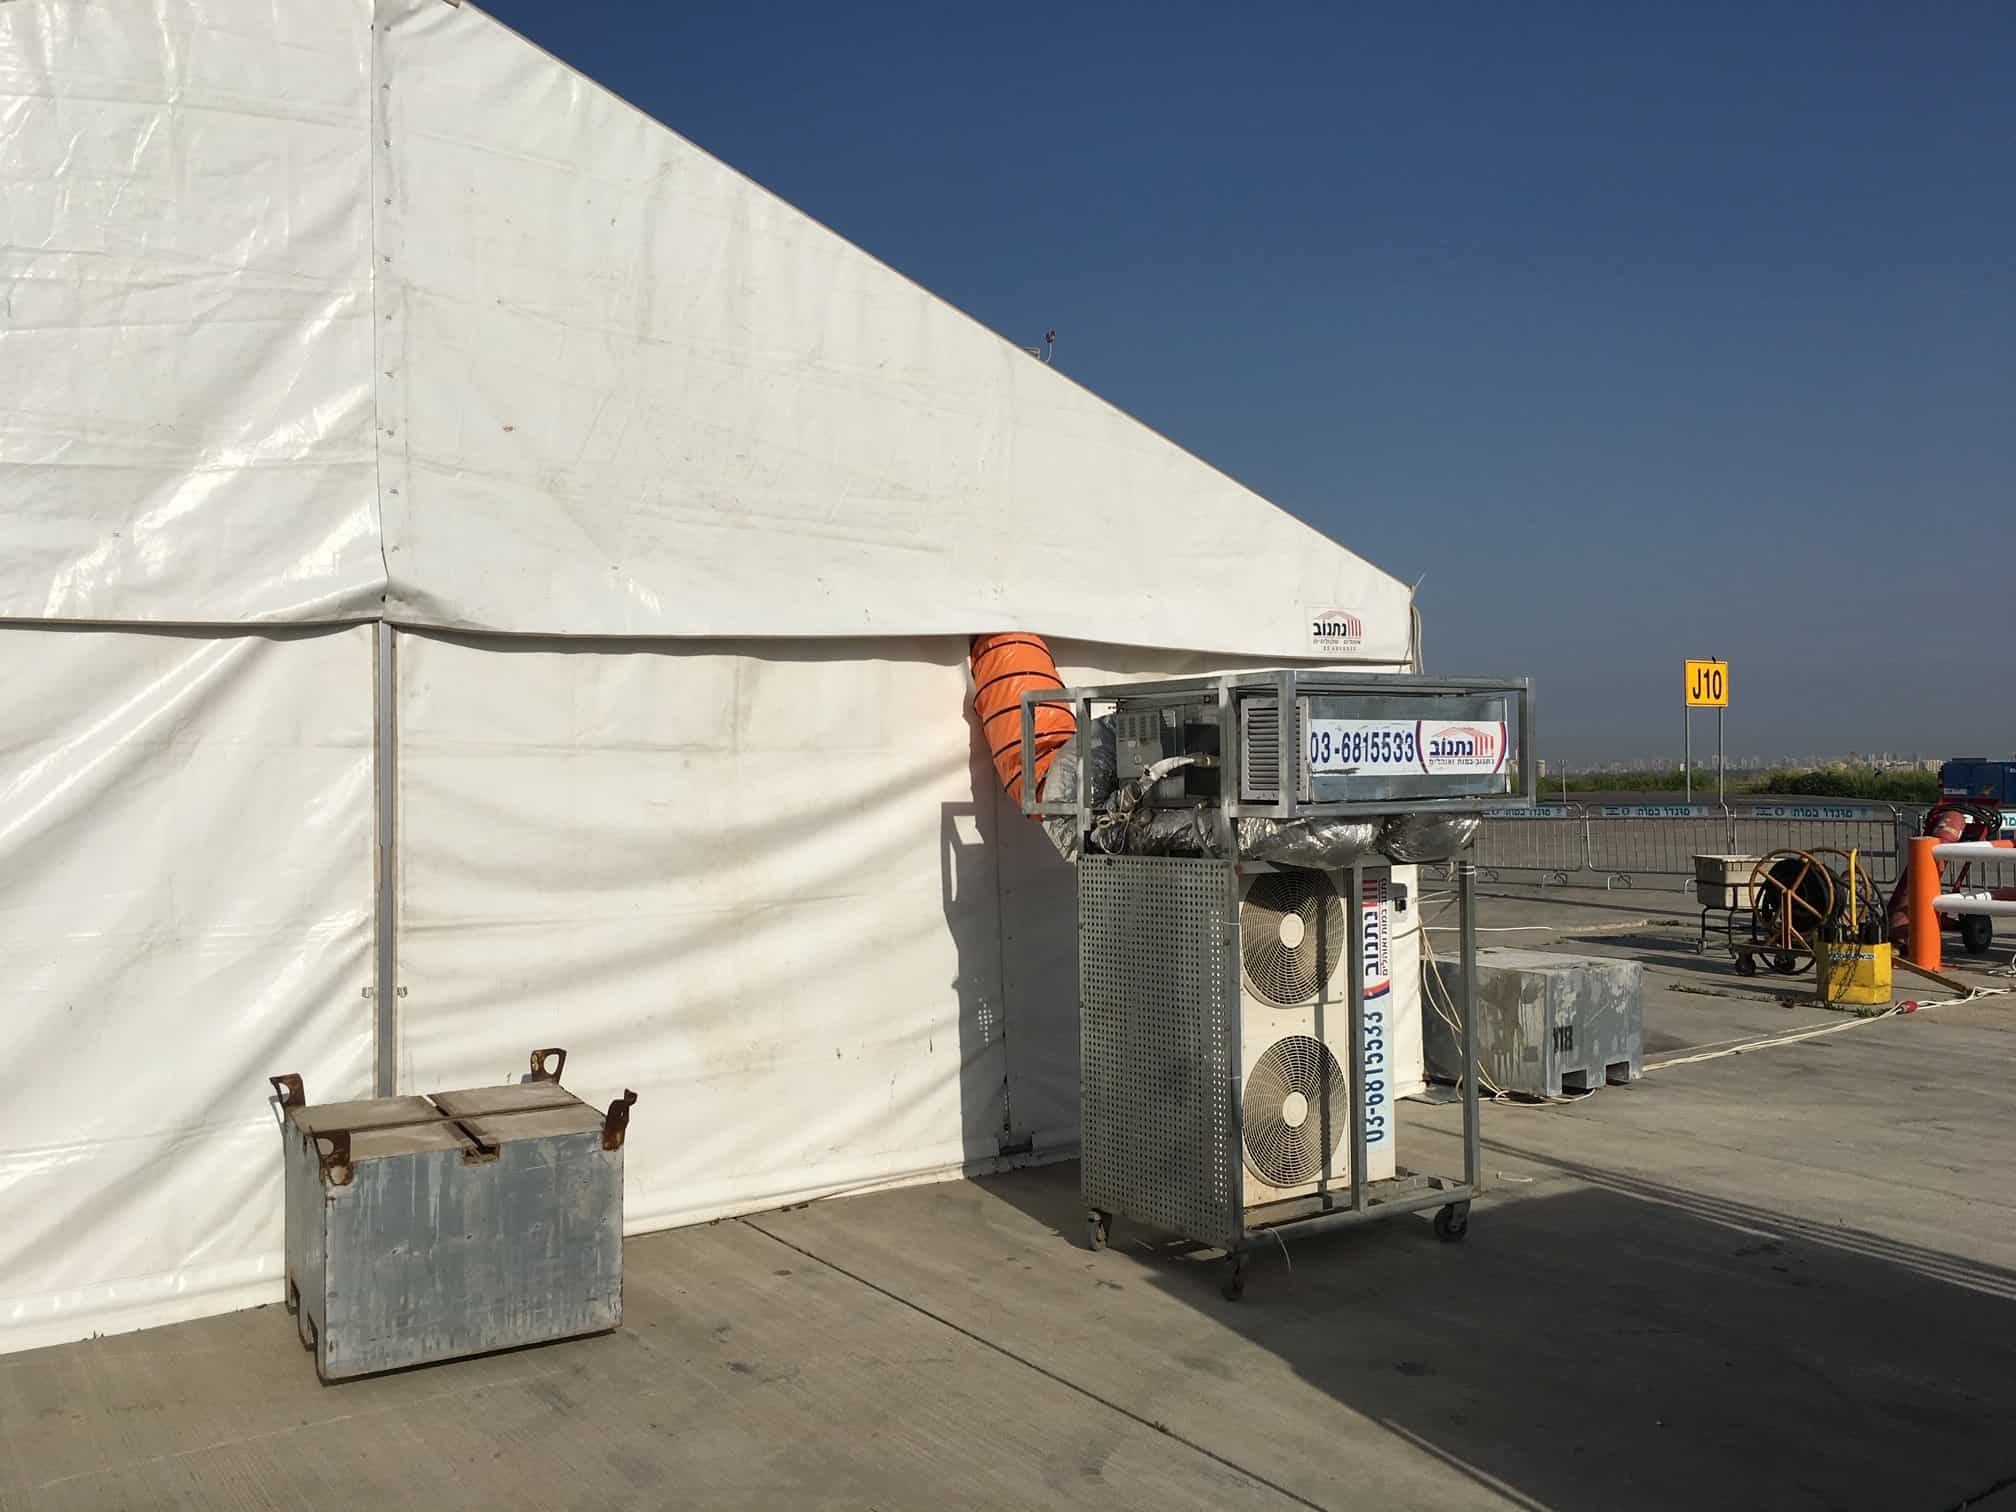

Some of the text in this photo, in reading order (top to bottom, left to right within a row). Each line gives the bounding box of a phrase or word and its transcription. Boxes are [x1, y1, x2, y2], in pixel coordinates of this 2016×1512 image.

[1692, 668, 1722, 700] J10
[1310, 731, 1415, 763] 03-6815533
[1364, 911, 1379, 977] נתנוב
[1363, 1011, 1385, 1143] 03-6815533
